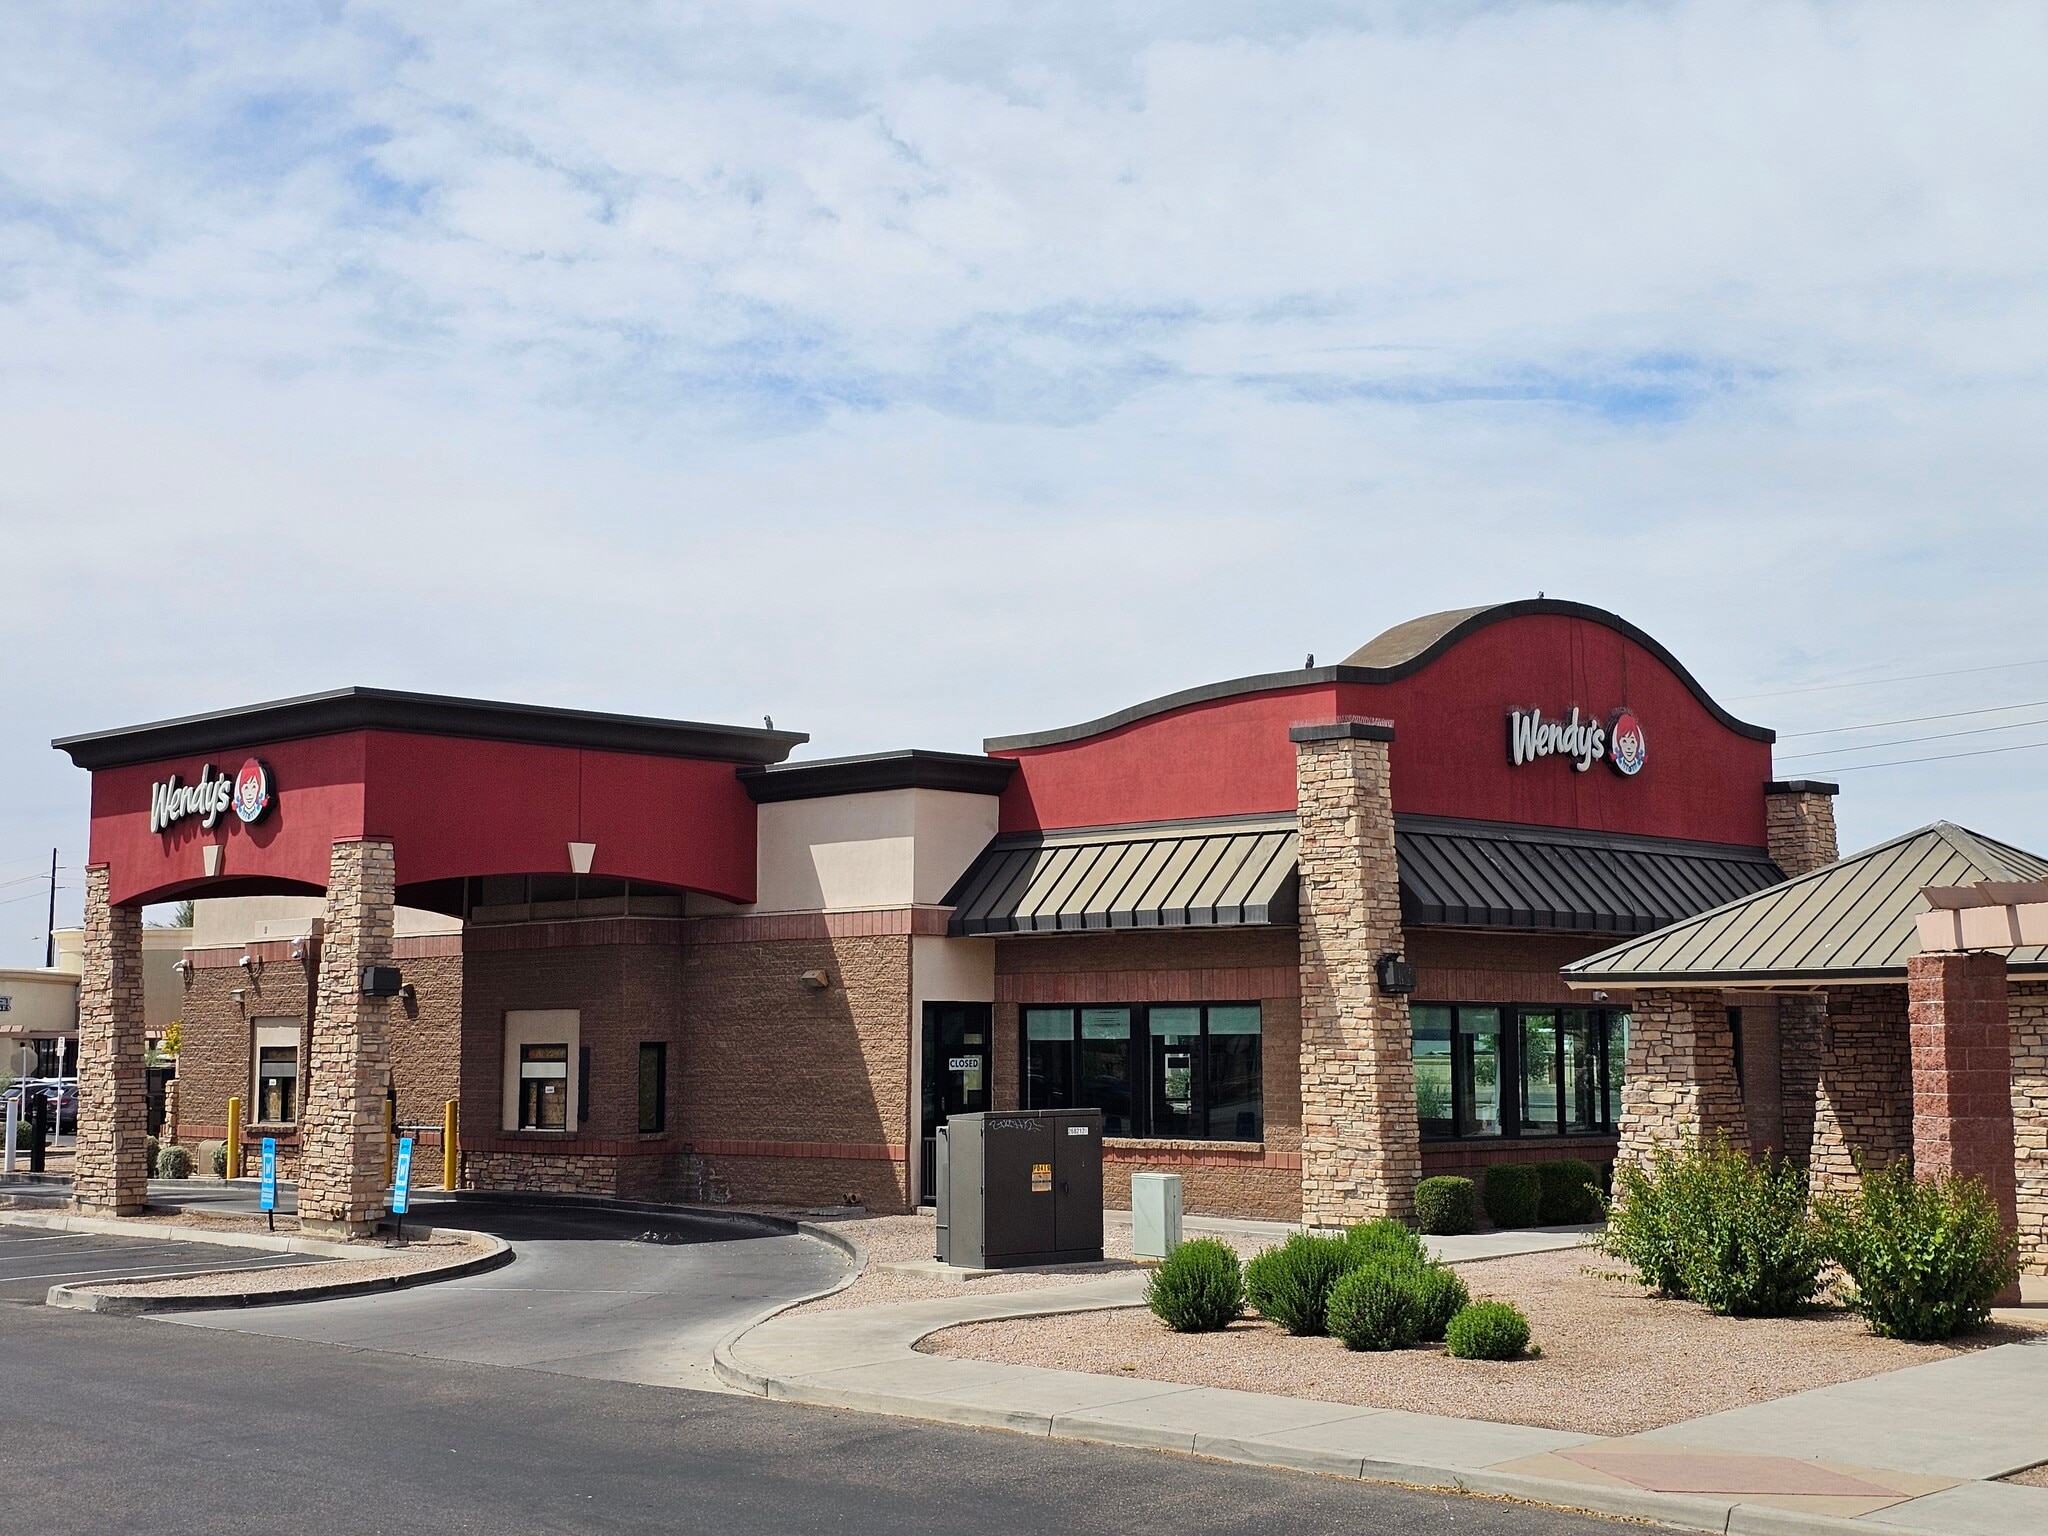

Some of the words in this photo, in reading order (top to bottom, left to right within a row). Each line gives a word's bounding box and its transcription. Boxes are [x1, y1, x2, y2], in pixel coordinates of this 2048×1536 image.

[1512, 706, 1605, 772] Wendy's
[150, 763, 231, 833] Wendy's
[949, 1059, 979, 1068] CLOSED
